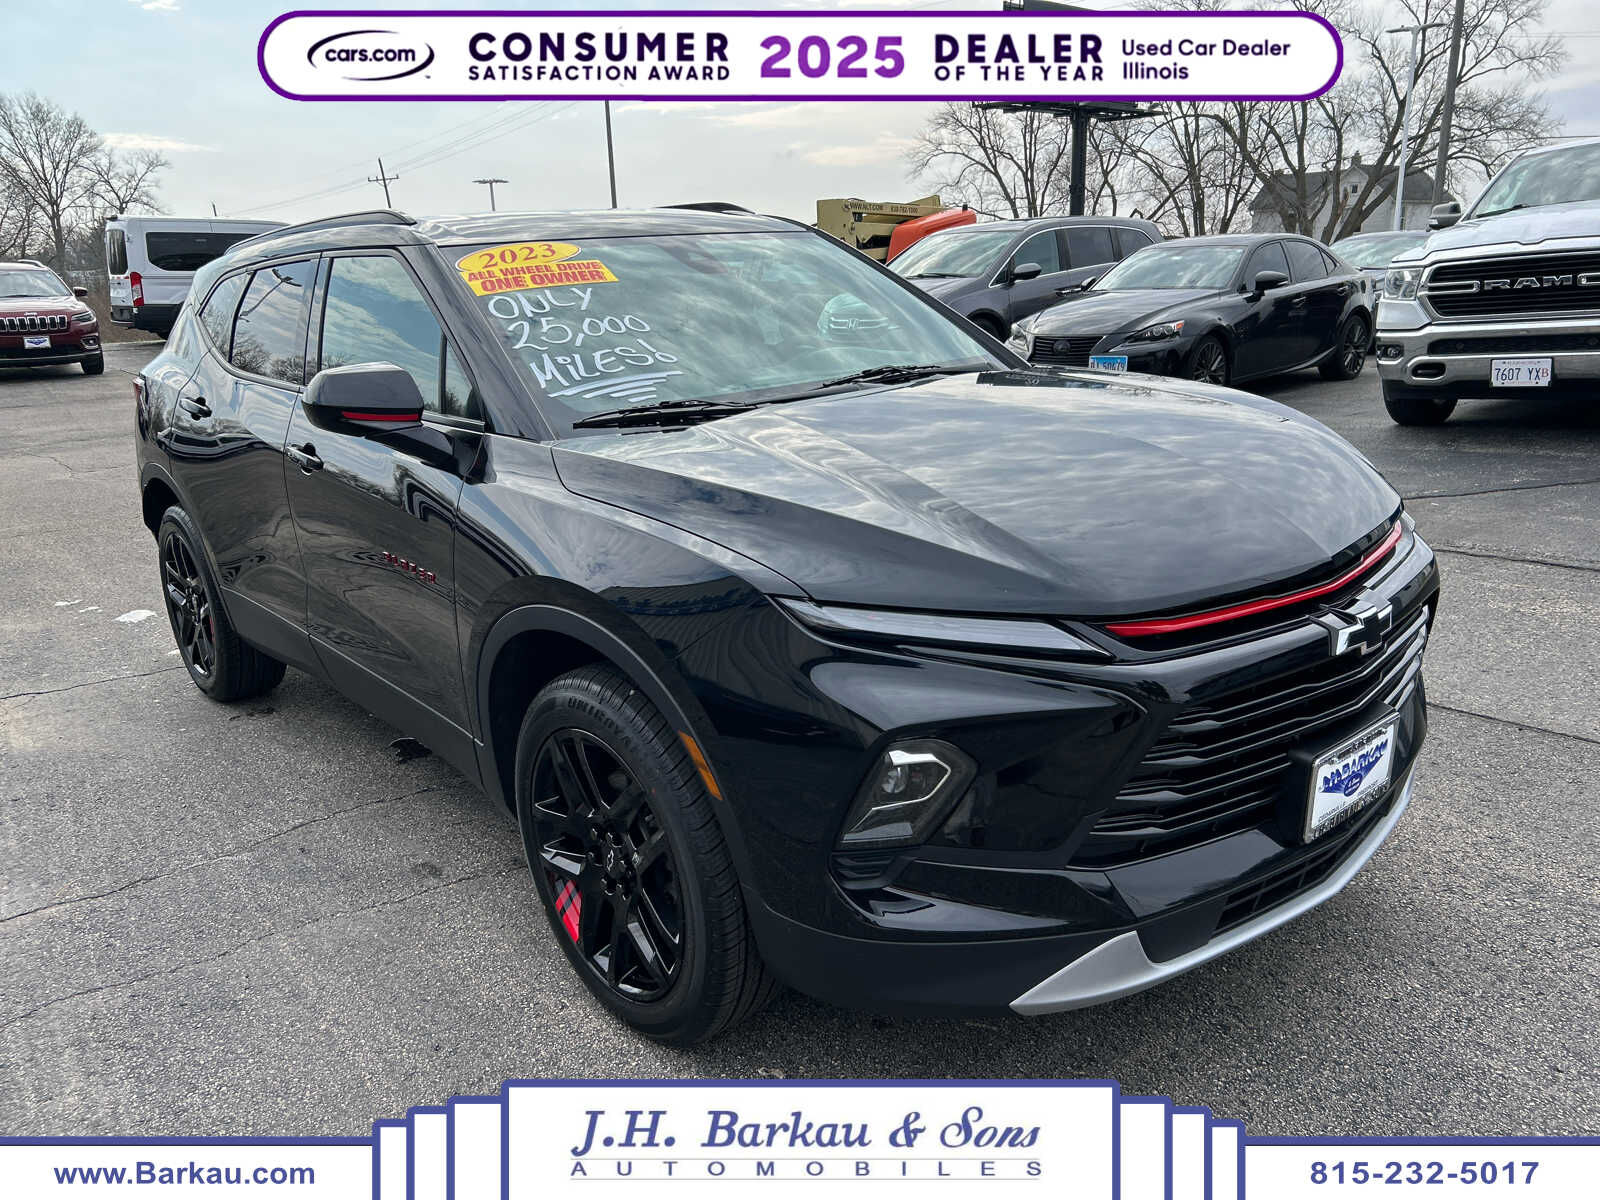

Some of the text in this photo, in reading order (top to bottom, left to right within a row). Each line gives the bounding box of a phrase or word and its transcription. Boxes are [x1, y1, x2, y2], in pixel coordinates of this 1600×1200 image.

[479, 243, 557, 269] 2023
[468, 261, 601, 282] ALL WHEEL DRIVE
[481, 269, 608, 292] ONE OWNER
[1484, 274, 1573, 291] RAM
[487, 287, 593, 319] ONLY
[507, 314, 650, 350] 25,000
[1495, 367, 1521, 381] 7607
